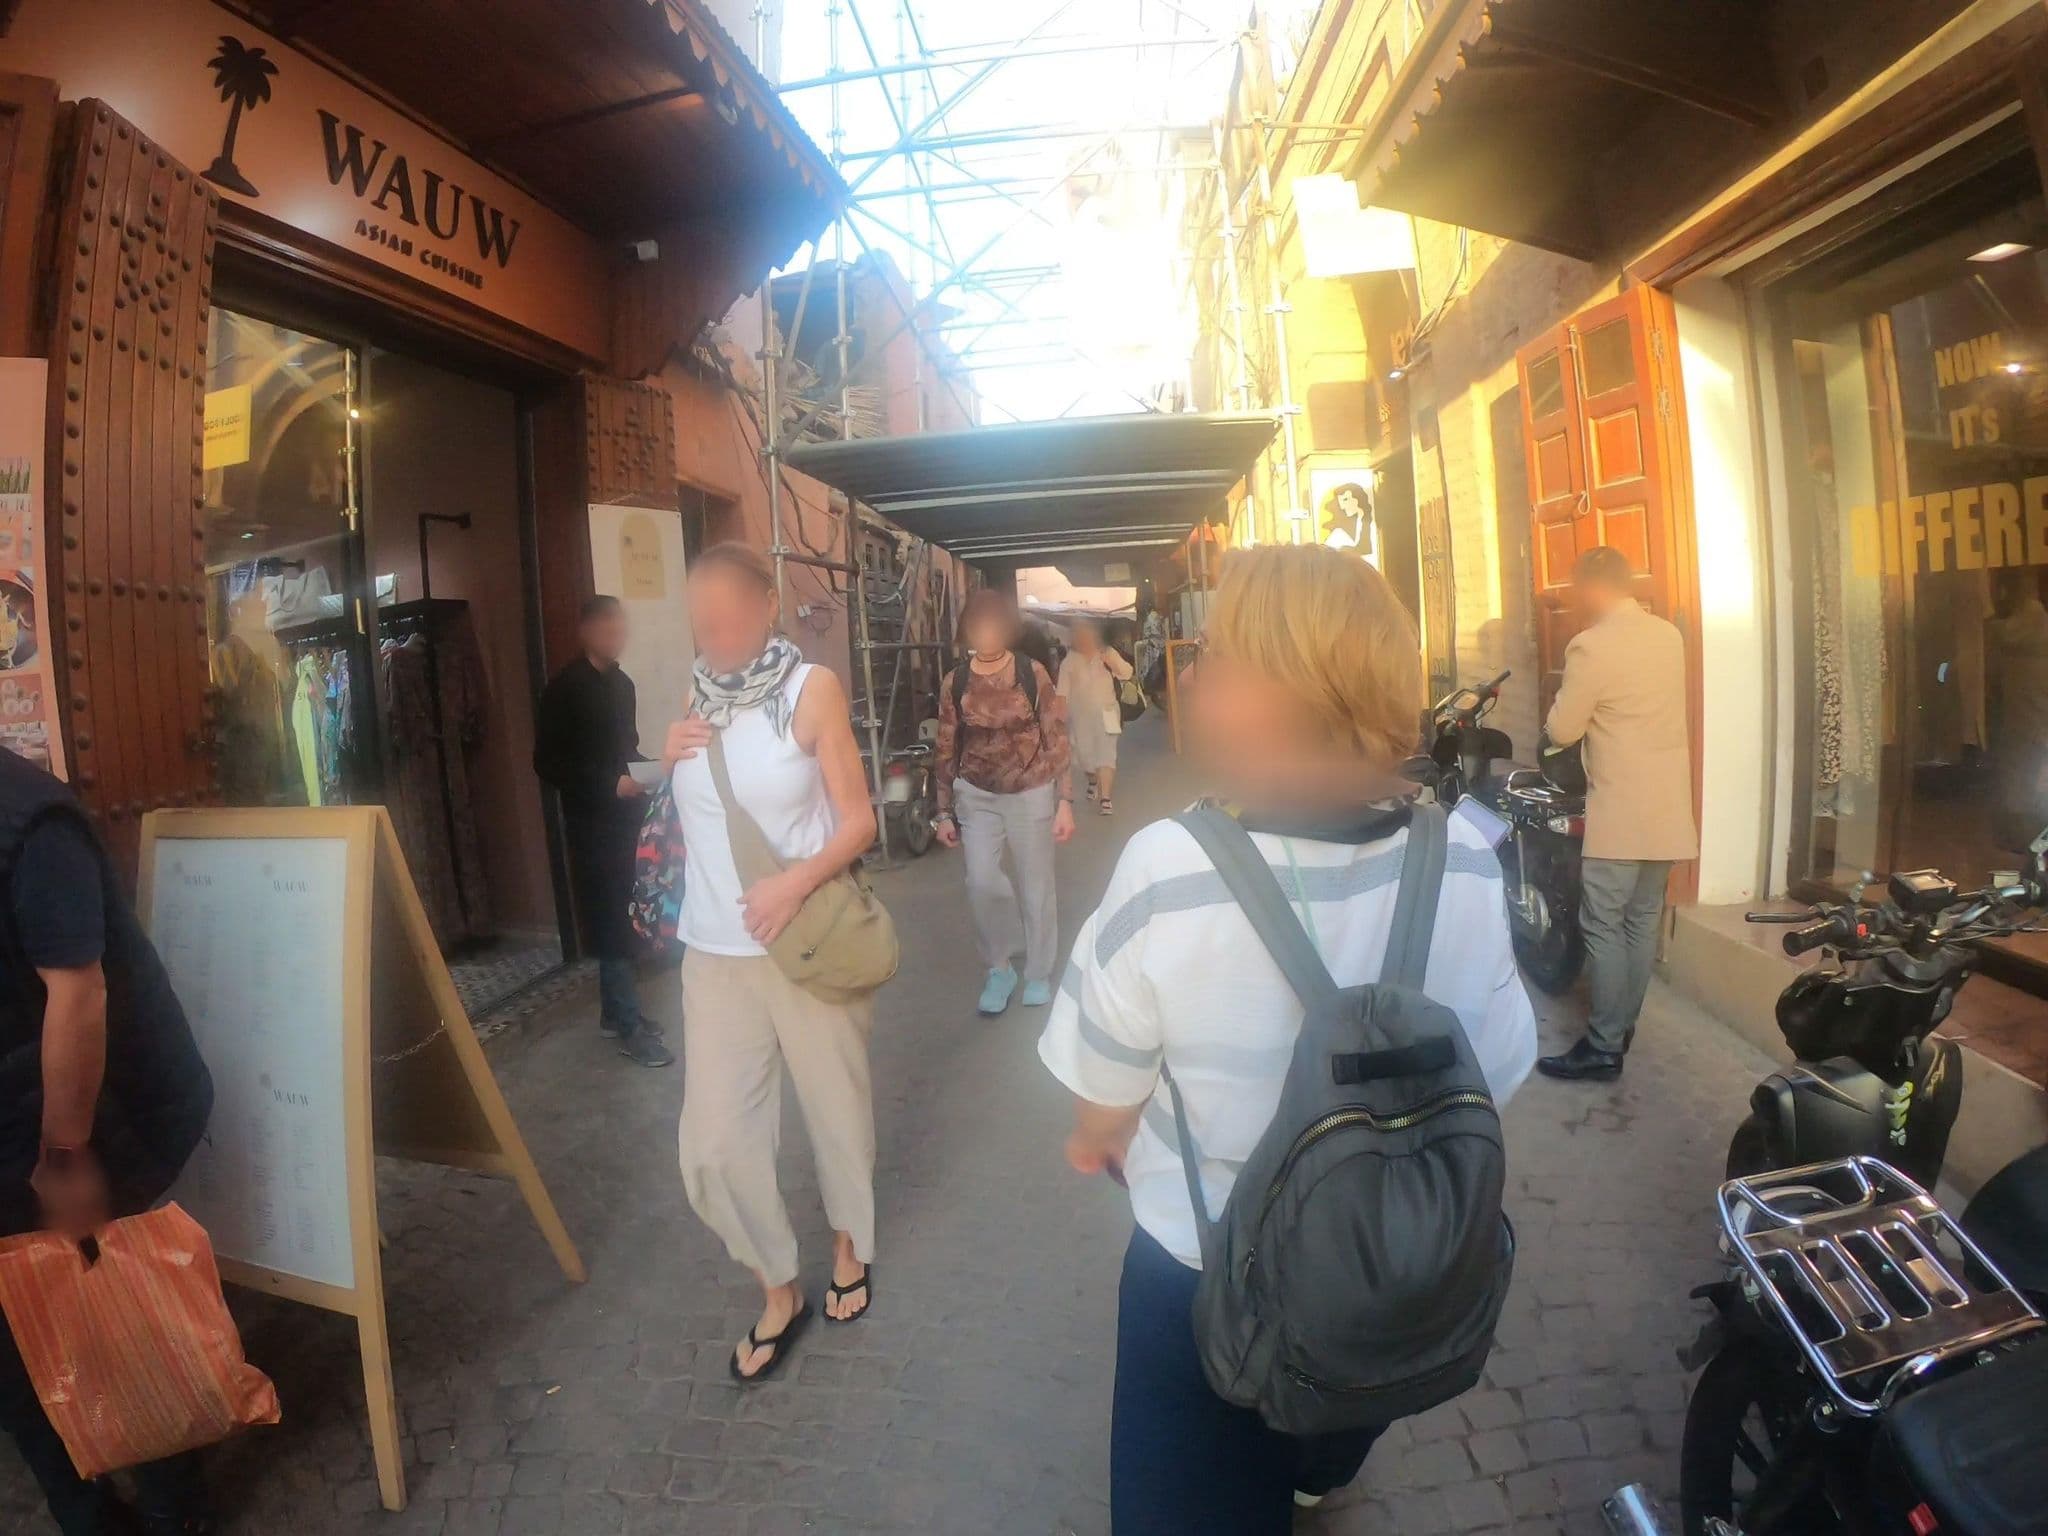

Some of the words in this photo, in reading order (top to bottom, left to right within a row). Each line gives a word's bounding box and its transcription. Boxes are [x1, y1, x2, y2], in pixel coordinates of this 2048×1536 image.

[316, 108, 521, 269] WAUW
[354, 219, 413, 257] ASIAN
[419, 248, 484, 289] CUISINE
[1850, 475, 2048, 577] DIFFERE
